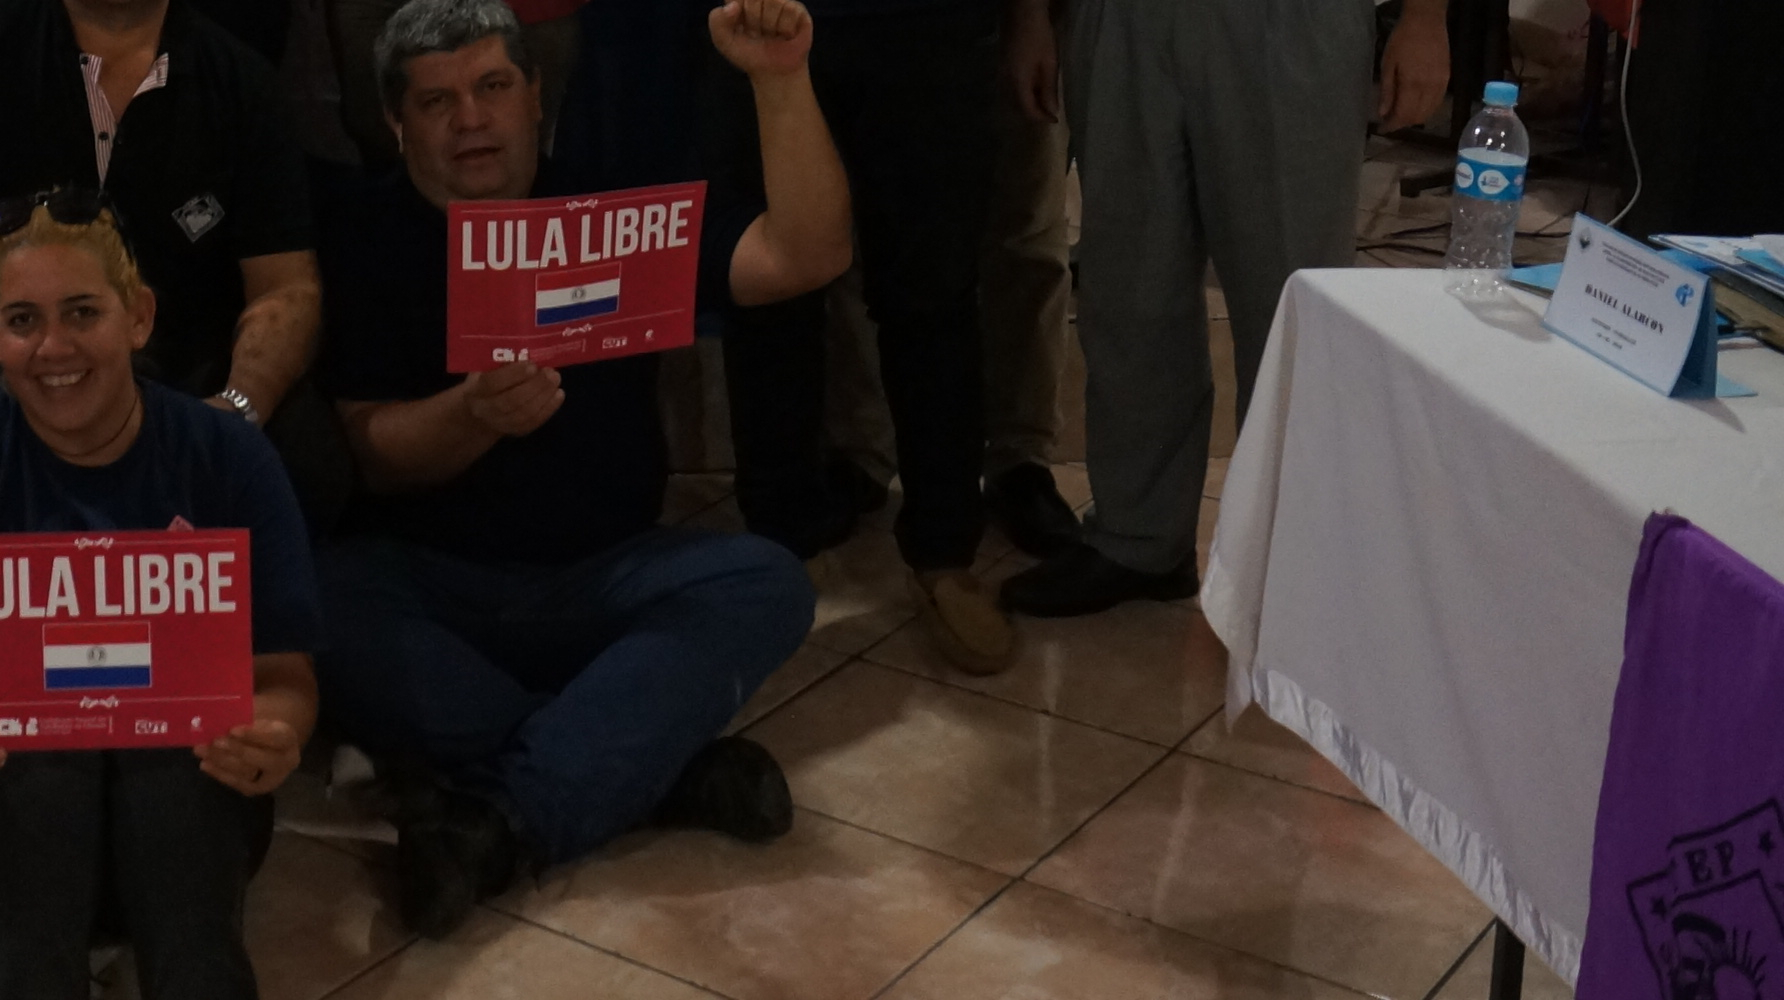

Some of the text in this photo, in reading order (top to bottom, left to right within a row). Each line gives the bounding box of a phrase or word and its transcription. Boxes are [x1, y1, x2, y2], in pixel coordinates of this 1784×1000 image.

[462, 200, 694, 271] LULA LIBRE
[94, 551, 237, 617] LIBRE
